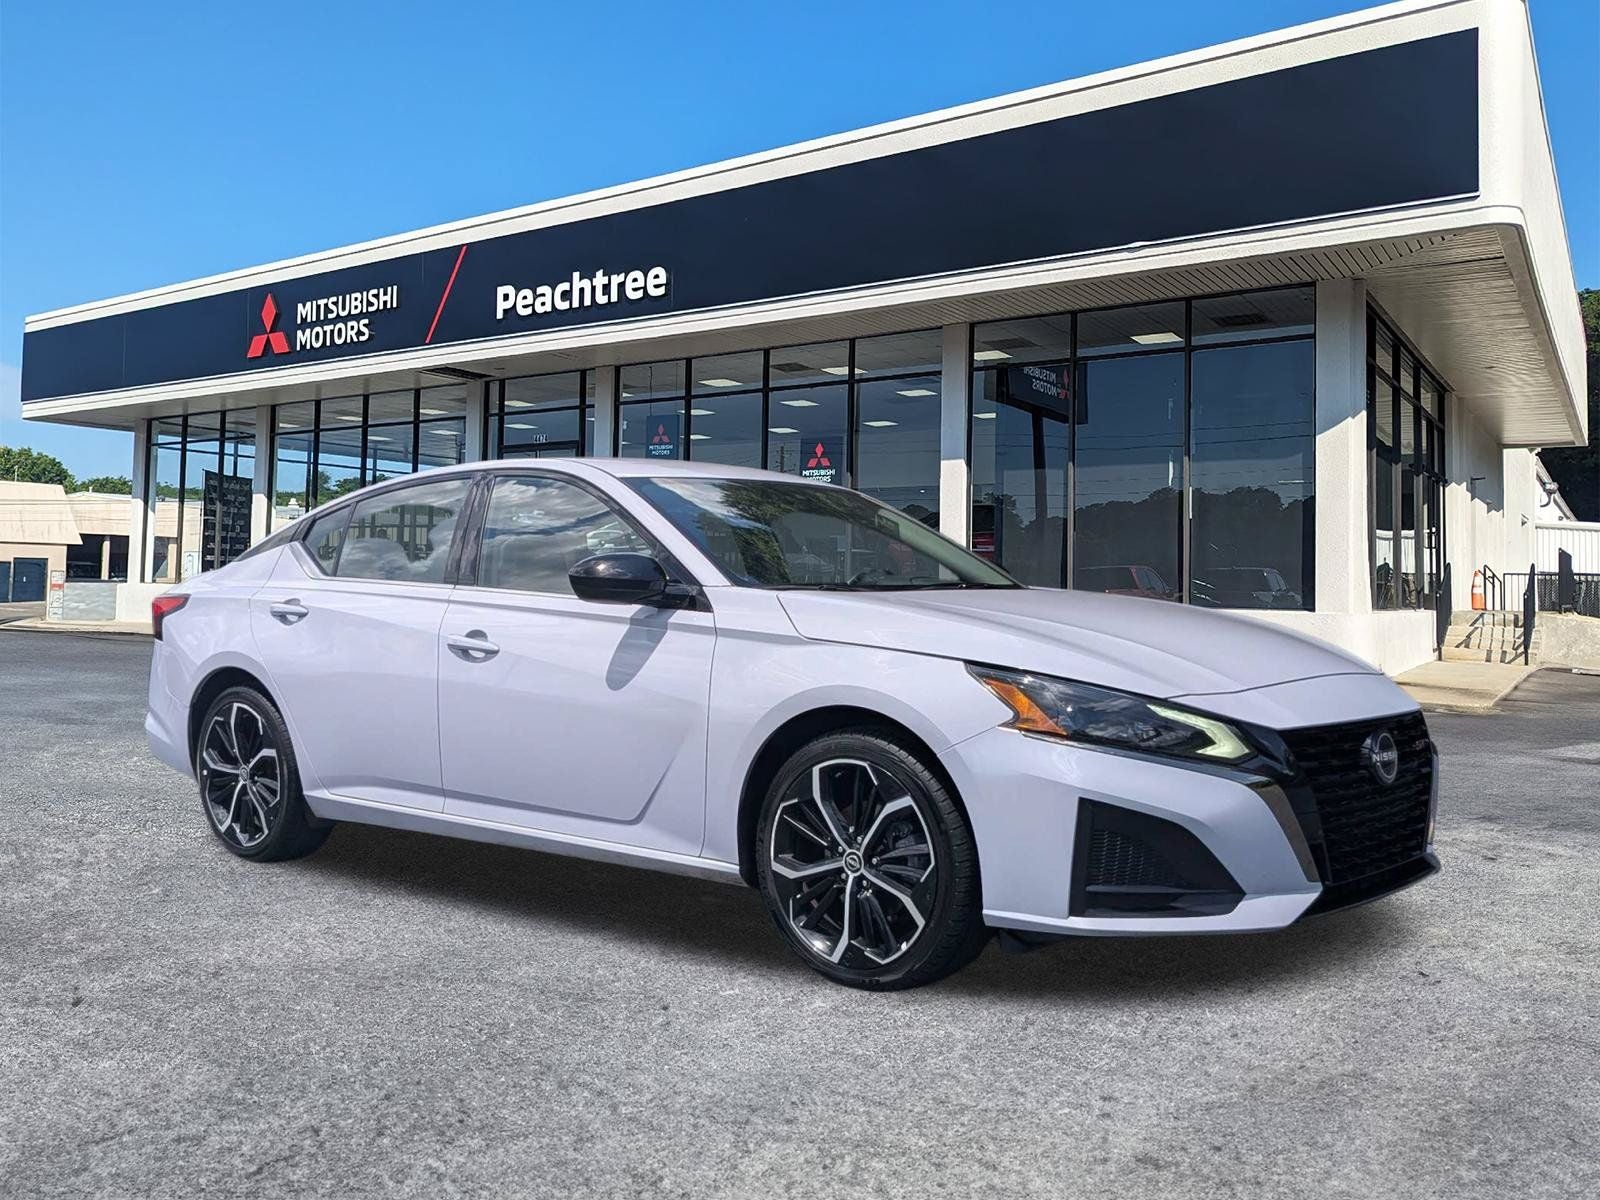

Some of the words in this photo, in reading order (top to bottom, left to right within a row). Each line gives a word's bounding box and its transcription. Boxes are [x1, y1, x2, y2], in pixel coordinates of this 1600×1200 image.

[297, 285, 398, 324] MITSUBISHI
[496, 266, 667, 320] Peachtree
[296, 319, 370, 351] MOTORS
[802, 469, 836, 477] MITSUBISHI
[1372, 751, 1398, 763] NISS
